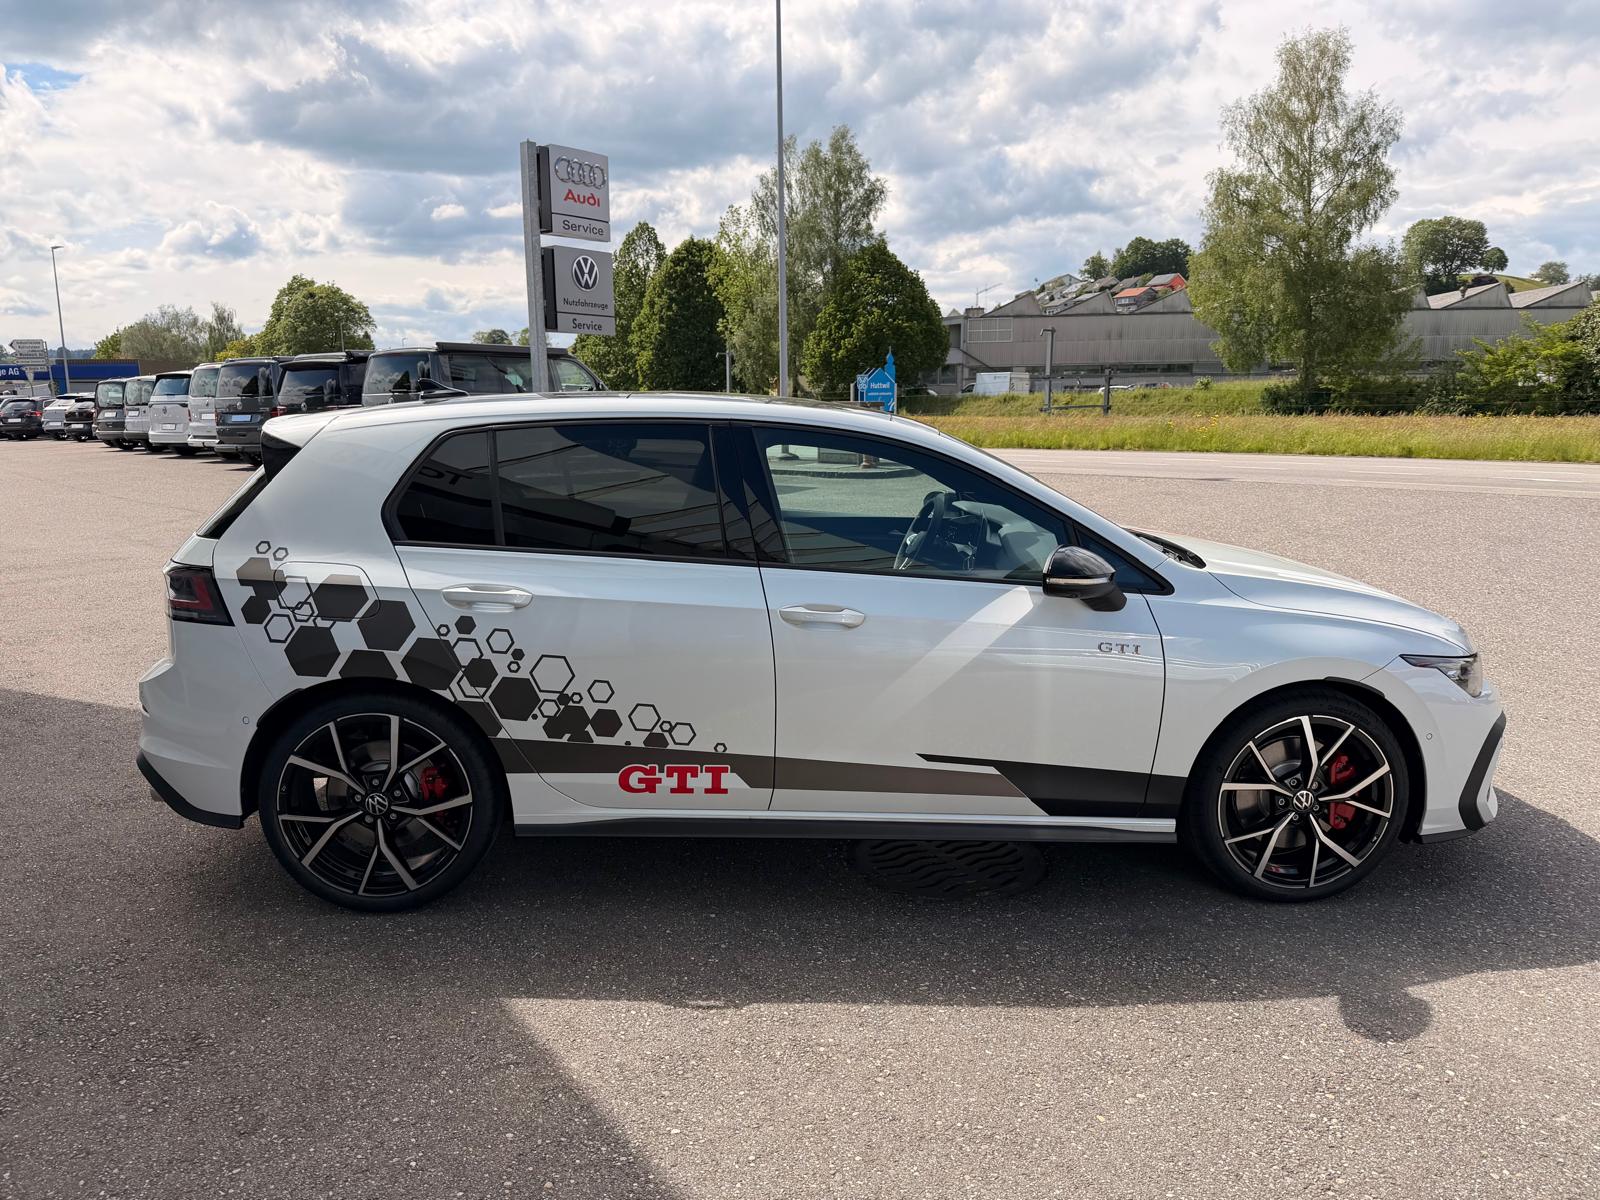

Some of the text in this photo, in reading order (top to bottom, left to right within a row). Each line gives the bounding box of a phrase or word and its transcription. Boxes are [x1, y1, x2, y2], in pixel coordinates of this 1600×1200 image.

[563, 188, 601, 208] Audi
[562, 219, 604, 236] Service
[563, 297, 609, 310] Nutzfahrzeuge
[572, 318, 603, 331] Service
[8, 368, 20, 376] AG
[1098, 641, 1141, 655] GTI
[618, 764, 730, 794] GTI
